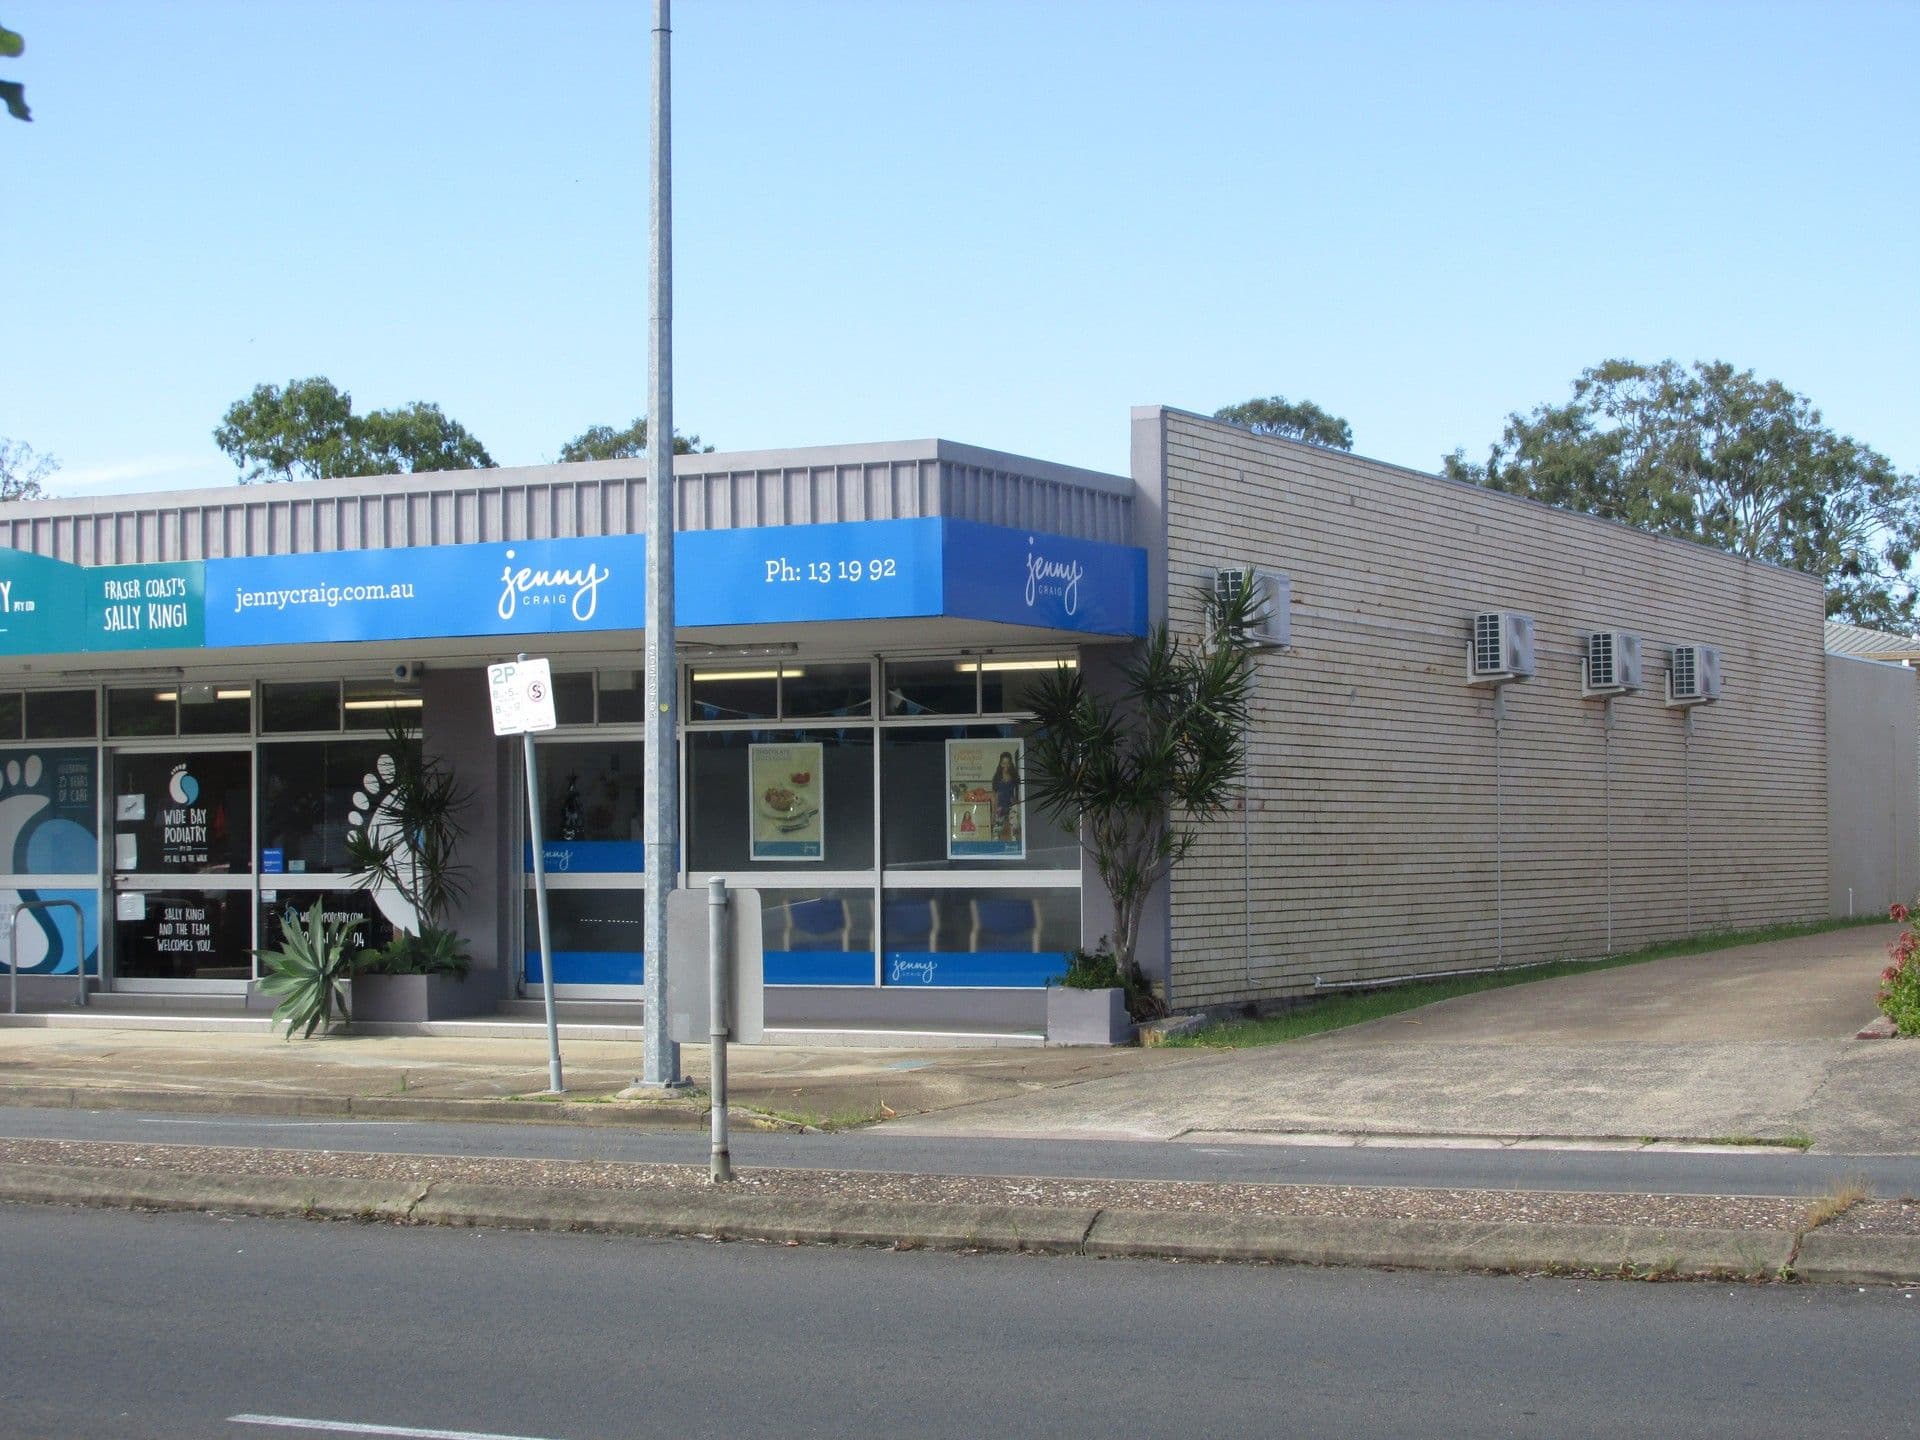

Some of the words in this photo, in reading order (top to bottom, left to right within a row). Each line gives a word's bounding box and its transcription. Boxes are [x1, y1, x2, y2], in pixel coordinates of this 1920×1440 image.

[765, 557, 801, 583] Ph:
[808, 562, 831, 583] 13
[838, 560, 862, 582] 19
[869, 558, 896, 581] 92
[1026, 536, 1083, 616] jenny
[104, 579, 141, 600] FRASER
[145, 577, 186, 598] COAST'S
[498, 549, 609, 621] jenny
[1038, 584, 1063, 597] CRAIG
[234, 582, 414, 613] jennycraig.com.au
[522, 594, 567, 606] CRAIG
[103, 604, 141, 632] SALLY
[491, 666, 516, 685] 2P
[163, 809, 187, 825] WIDE
[190, 808, 207, 824] BAY
[164, 825, 207, 844] PODIATRY
[164, 907, 183, 921] SALLY
[159, 922, 173, 936] AND
[175, 923, 188, 935] THE
[191, 923, 210, 936] TEAM
[892, 953, 938, 984] jenny
